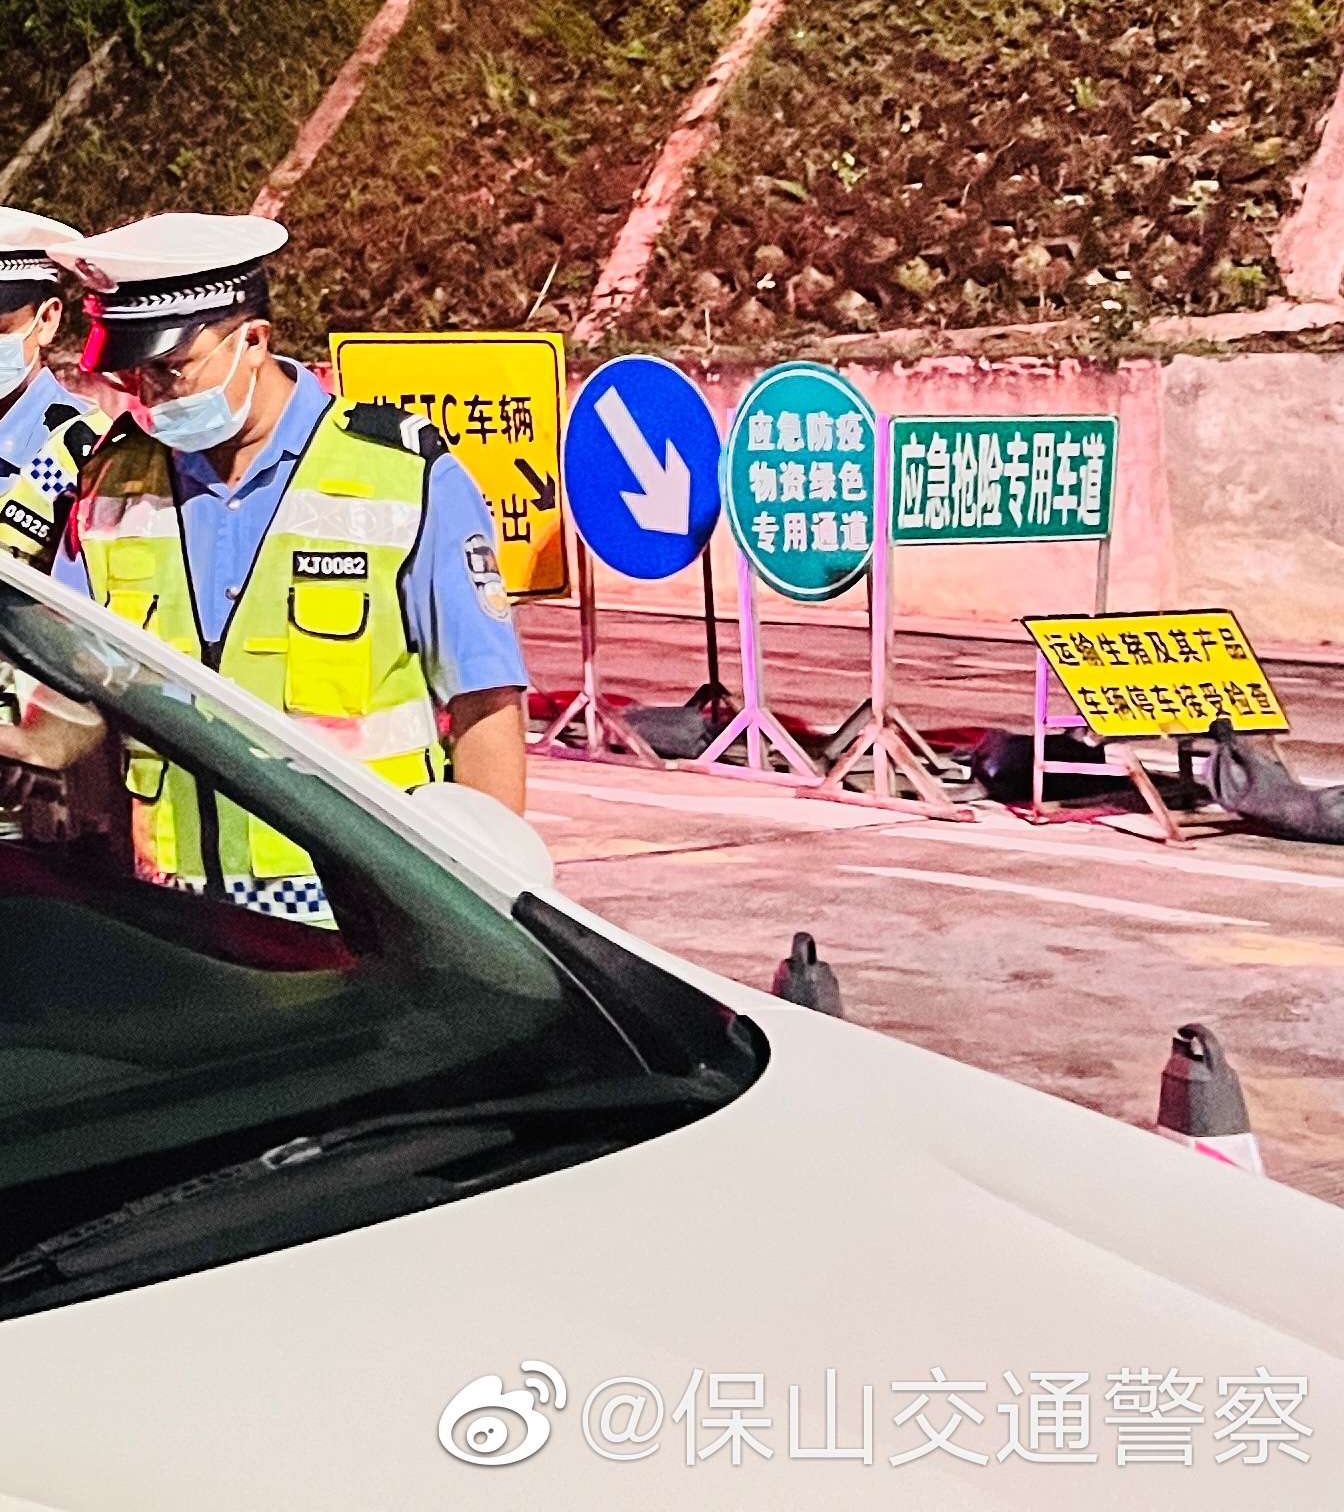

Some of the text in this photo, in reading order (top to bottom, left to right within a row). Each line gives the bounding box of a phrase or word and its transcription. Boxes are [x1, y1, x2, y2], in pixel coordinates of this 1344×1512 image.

[747, 410, 865, 453] 应急防疫
[749, 461, 868, 503] 物资绿色
[898, 431, 1107, 528] 应急抢险专用车道
[751, 510, 870, 555] 专用通道
